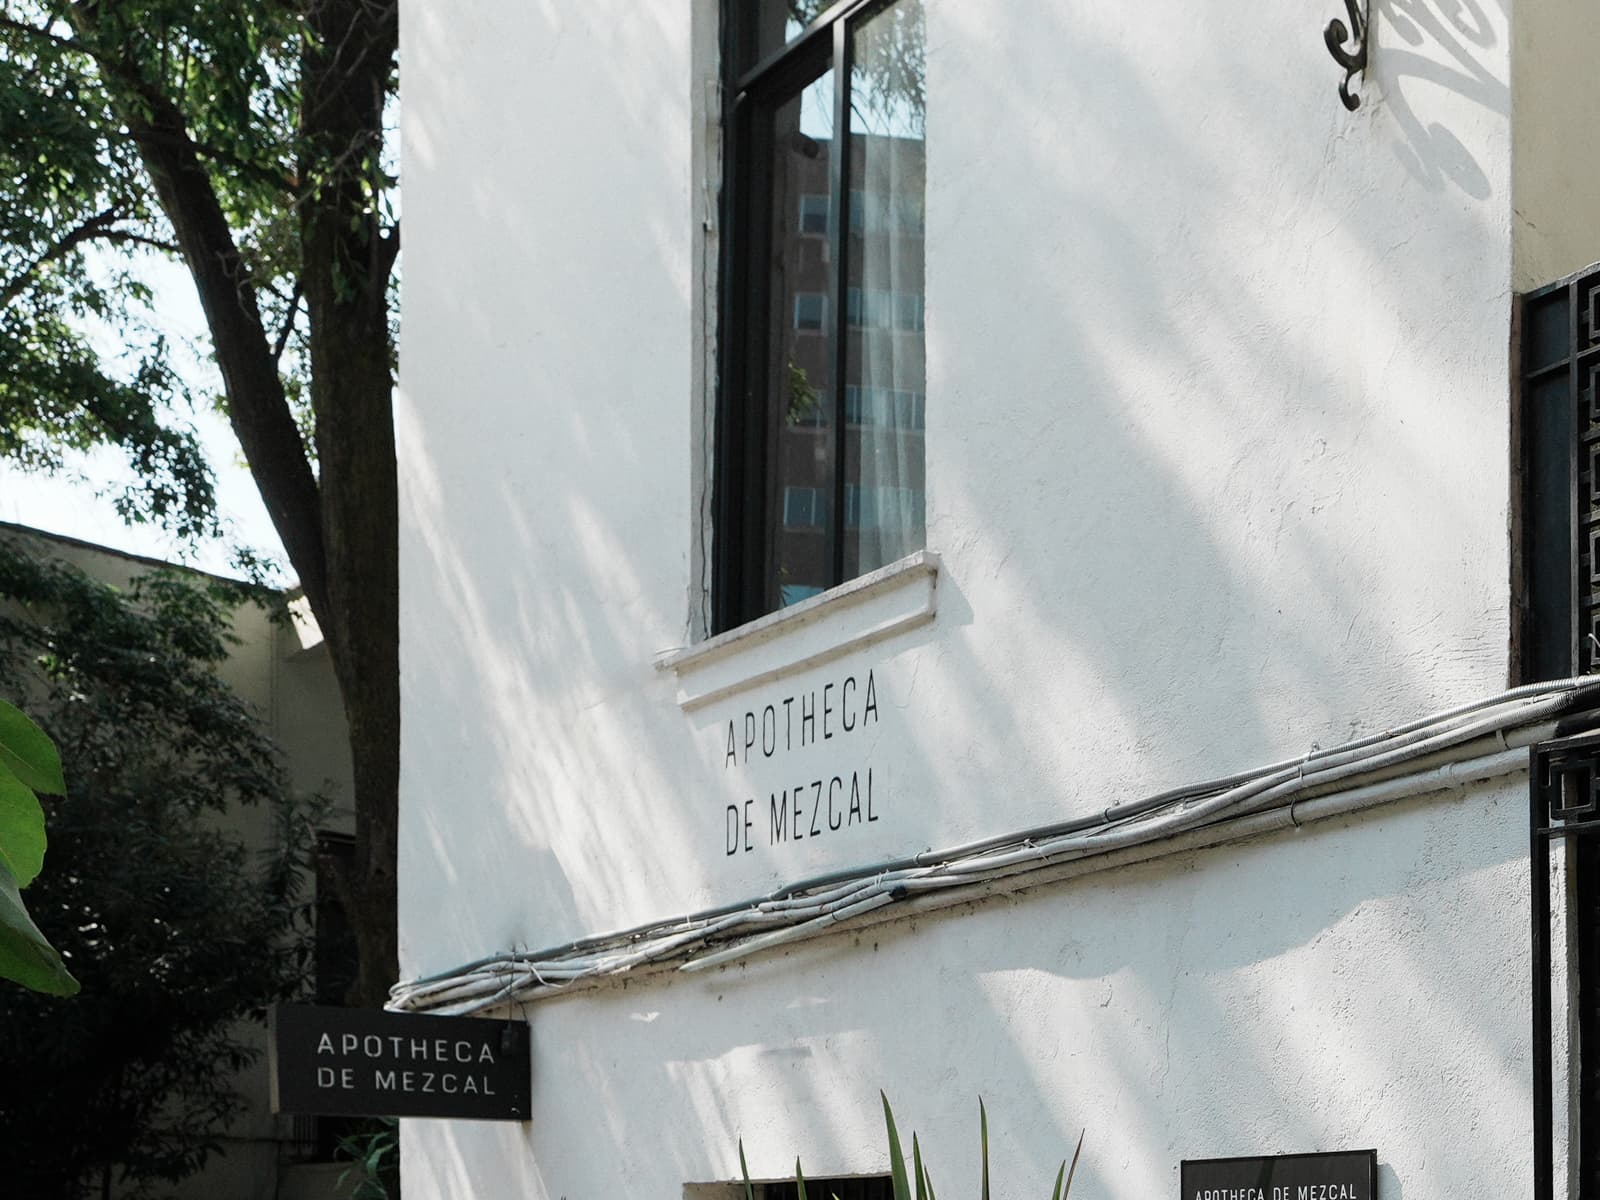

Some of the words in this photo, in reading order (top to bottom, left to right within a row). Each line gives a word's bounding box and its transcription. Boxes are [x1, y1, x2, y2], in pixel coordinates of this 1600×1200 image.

[725, 668, 879, 769] APOTHECA
[726, 799, 754, 857] DE
[770, 767, 879, 846] MEZCAL
[317, 1032, 496, 1065] APOTHECA
[317, 1066, 355, 1090] DE
[375, 1070, 497, 1096] MEZCAL
[1298, 1183, 1357, 1200] MEZCAL
